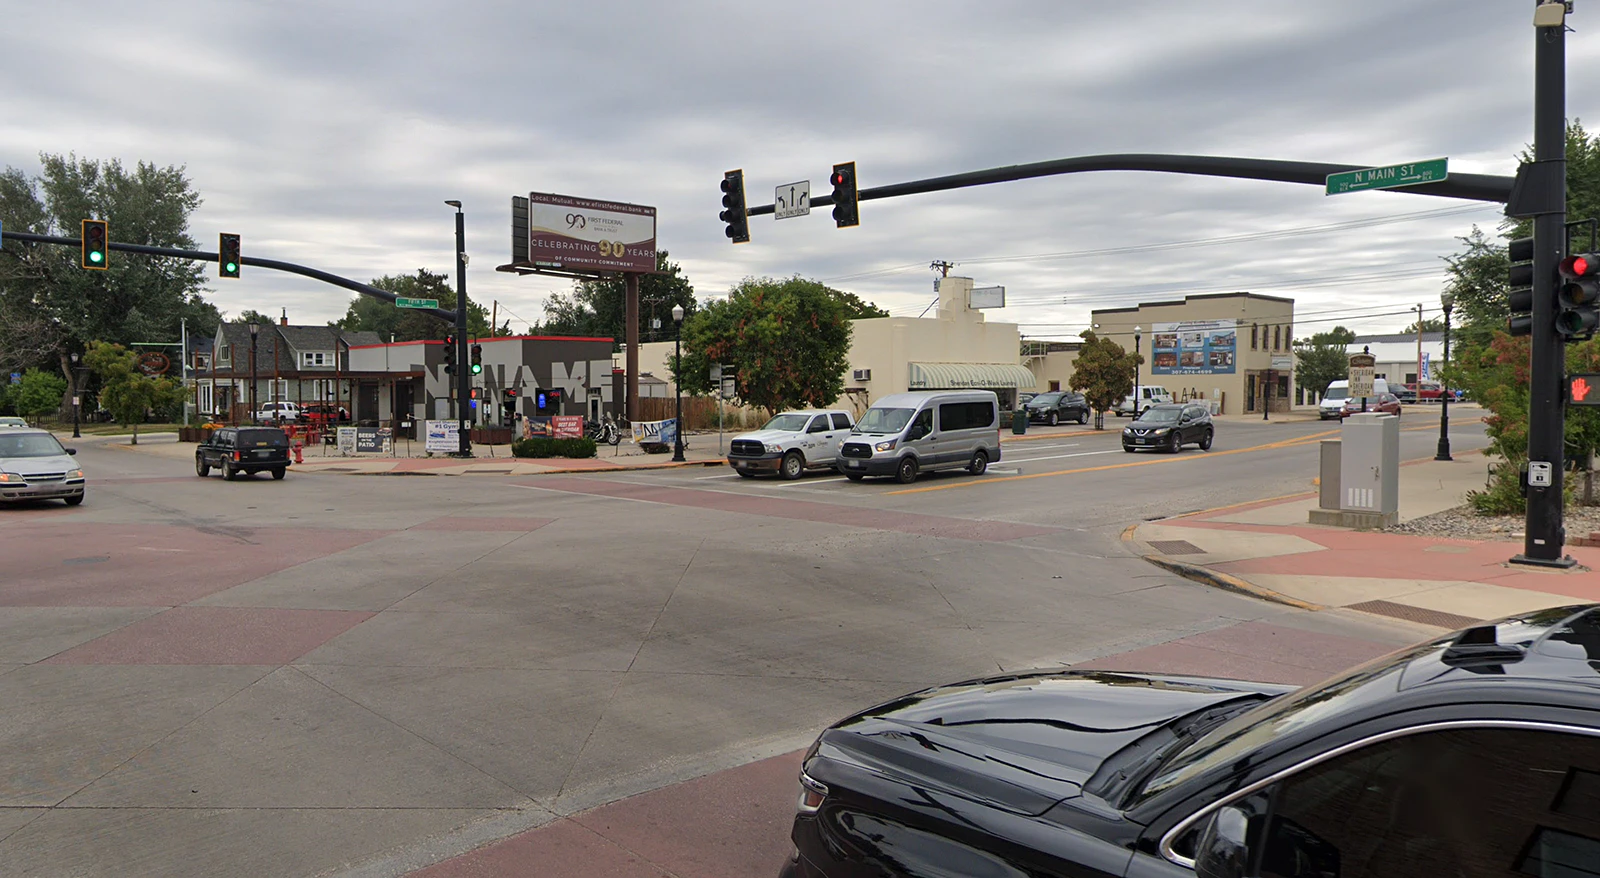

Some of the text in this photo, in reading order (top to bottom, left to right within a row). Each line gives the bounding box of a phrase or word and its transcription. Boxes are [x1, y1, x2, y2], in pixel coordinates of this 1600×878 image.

[1355, 165, 1415, 182] N MAIN ST
[602, 218, 623, 226] FEDERAL
[532, 239, 655, 258] CELEBRATING 90 YEARS
[564, 256, 597, 264] COMMUNITY
[598, 259, 634, 267] COMMITMENT
